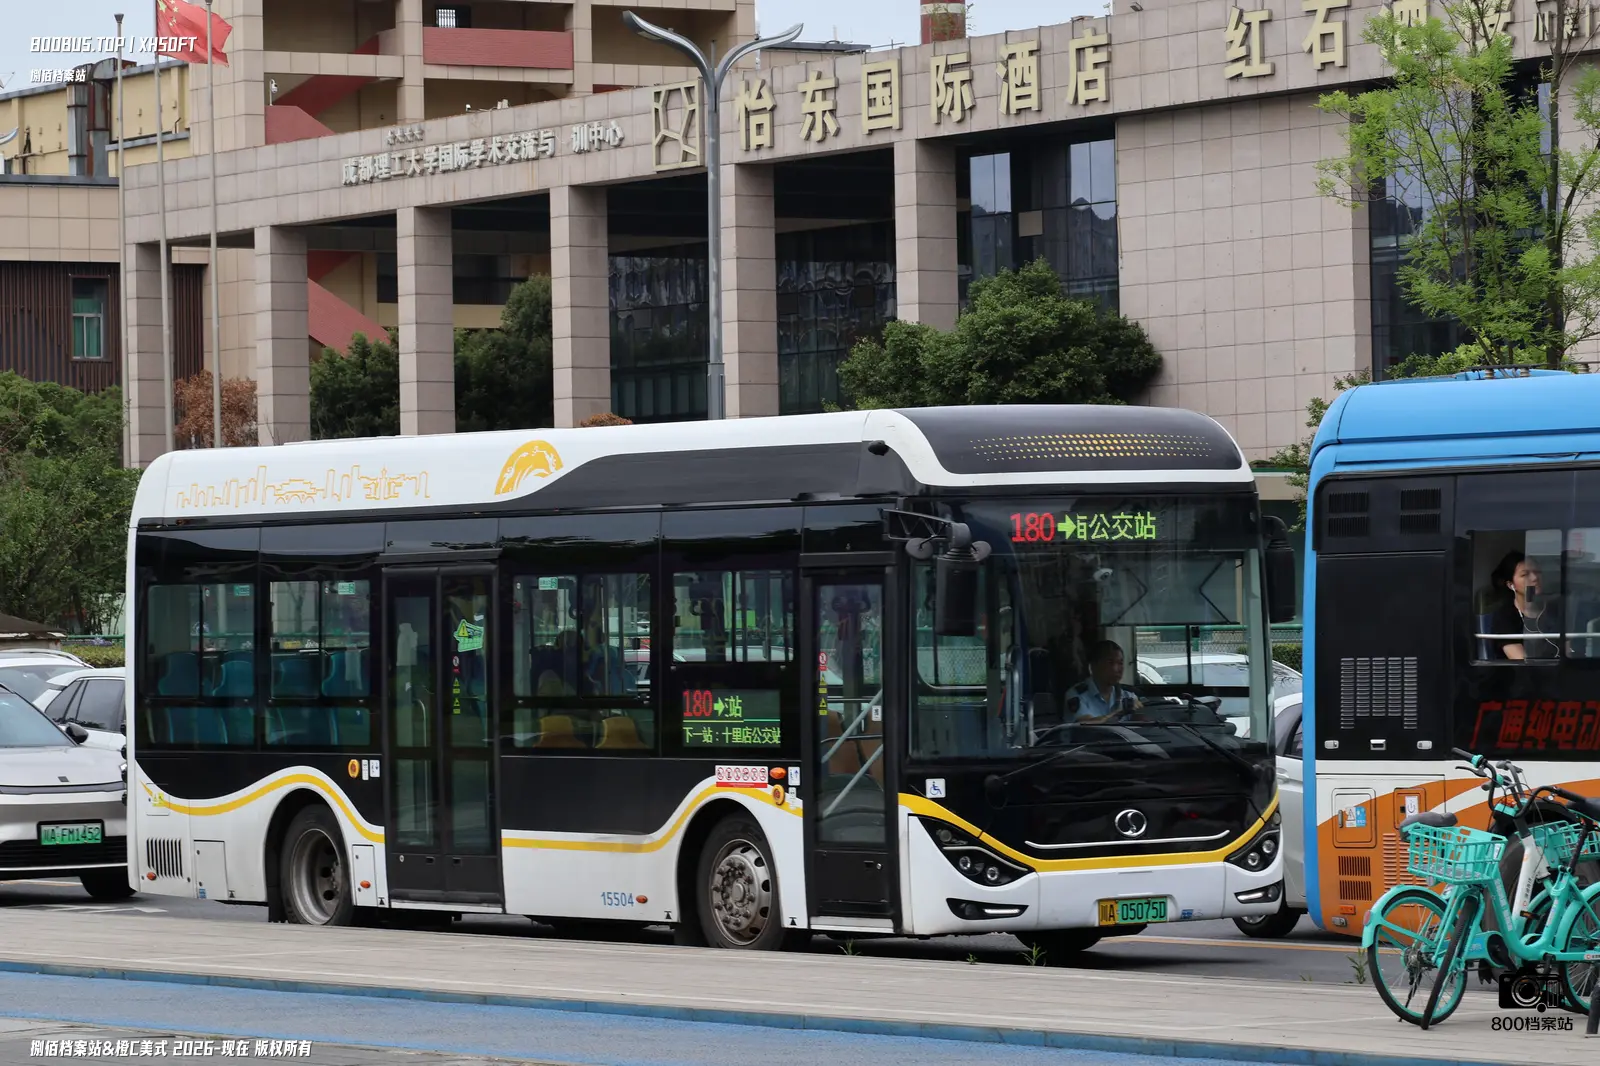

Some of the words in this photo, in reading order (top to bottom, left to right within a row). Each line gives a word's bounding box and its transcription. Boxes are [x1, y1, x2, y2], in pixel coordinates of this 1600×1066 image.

[735, 28, 1111, 151] 怡东国际酒店
[1010, 512, 1056, 542] 180
[683, 690, 712, 717] 180
[600, 891, 634, 906] 15504
